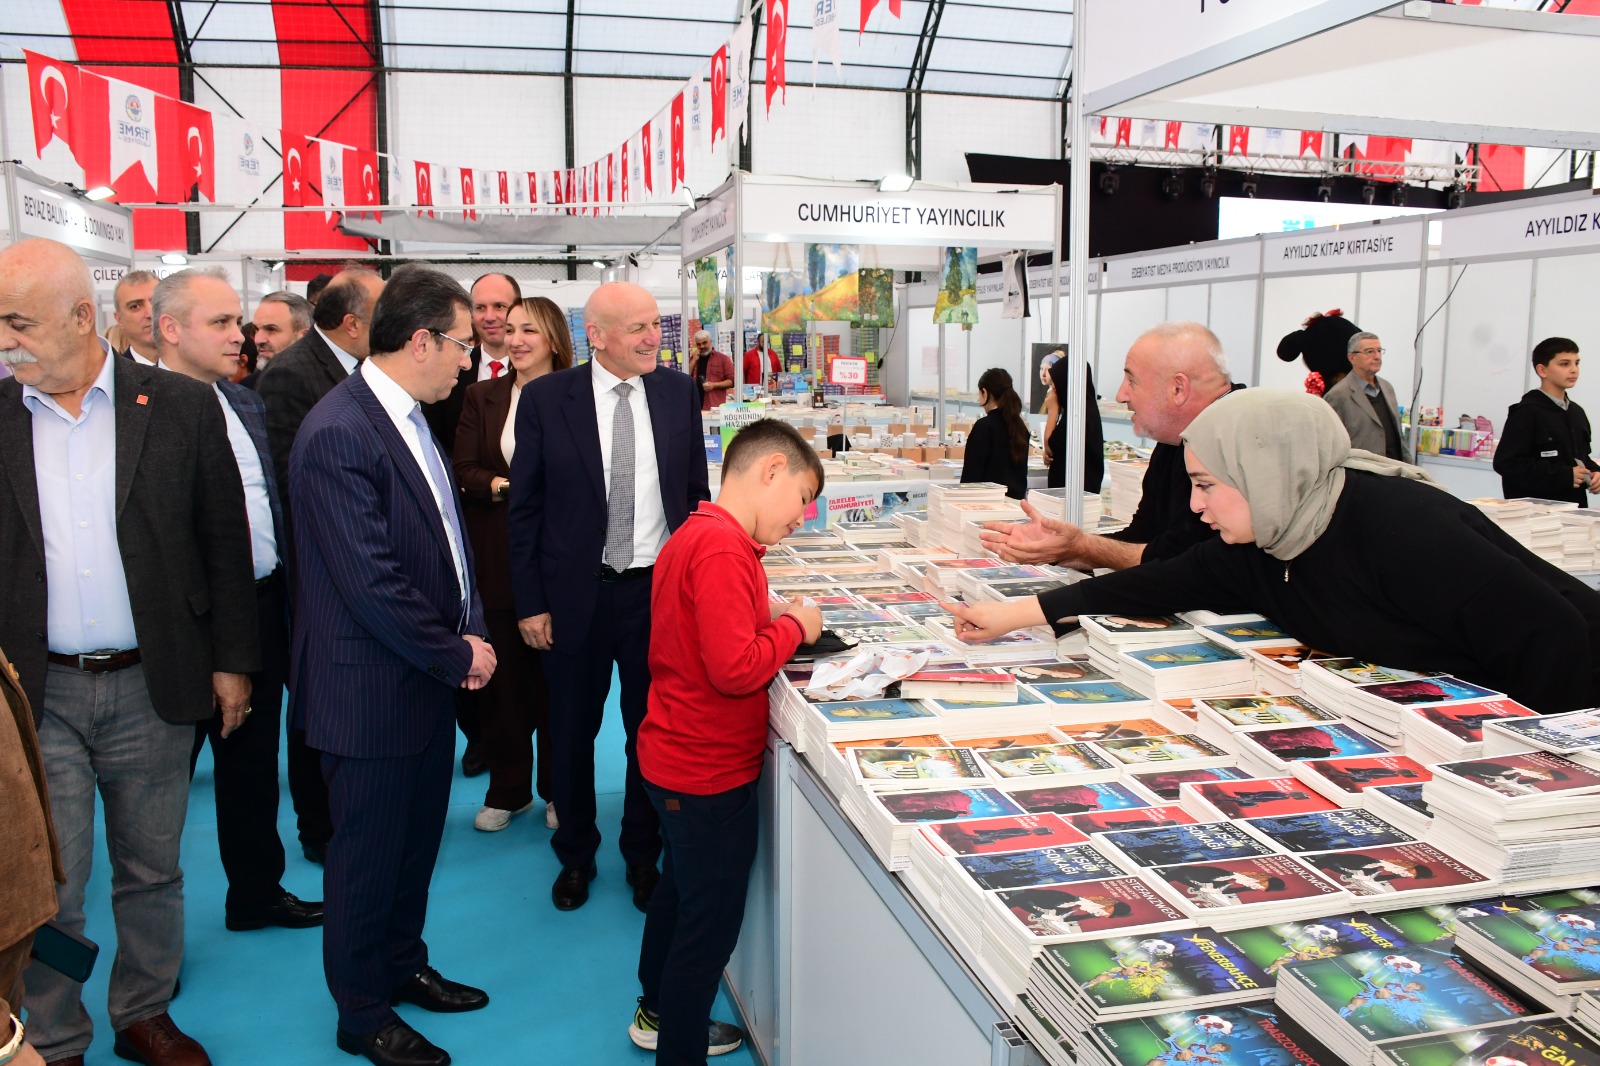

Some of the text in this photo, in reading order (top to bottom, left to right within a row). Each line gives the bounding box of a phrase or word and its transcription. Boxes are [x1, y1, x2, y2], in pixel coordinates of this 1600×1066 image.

[24, 195, 46, 220] BEYAZ
[798, 202, 1005, 227] CUMHURİYET YAYINCILIK
[1525, 213, 1588, 237] AYYILDIZ
[1283, 236, 1394, 260] AYYILDIZ KİTAP KIRTASİYE
[93, 269, 124, 283] ÇİLEK
[839, 371, 859, 380] %30
[828, 496, 856, 505] FARELER
[828, 498, 875, 511] CUMHURİYETİ
[1321, 812, 1366, 835] SOKAĞI
[1184, 826, 1225, 849] SOKAĞI
[1041, 848, 1081, 874] SOKAĞI
[1072, 856, 1100, 871] IŞIĞI
[1078, 845, 1106, 864] STEFAN
[1356, 926, 1393, 948] FENER
[1196, 941, 1257, 987] FENERBAHÇE
[1444, 960, 1522, 1014] TRABZONSPOR
[1259, 1019, 1319, 1066] TRABZONSPO
